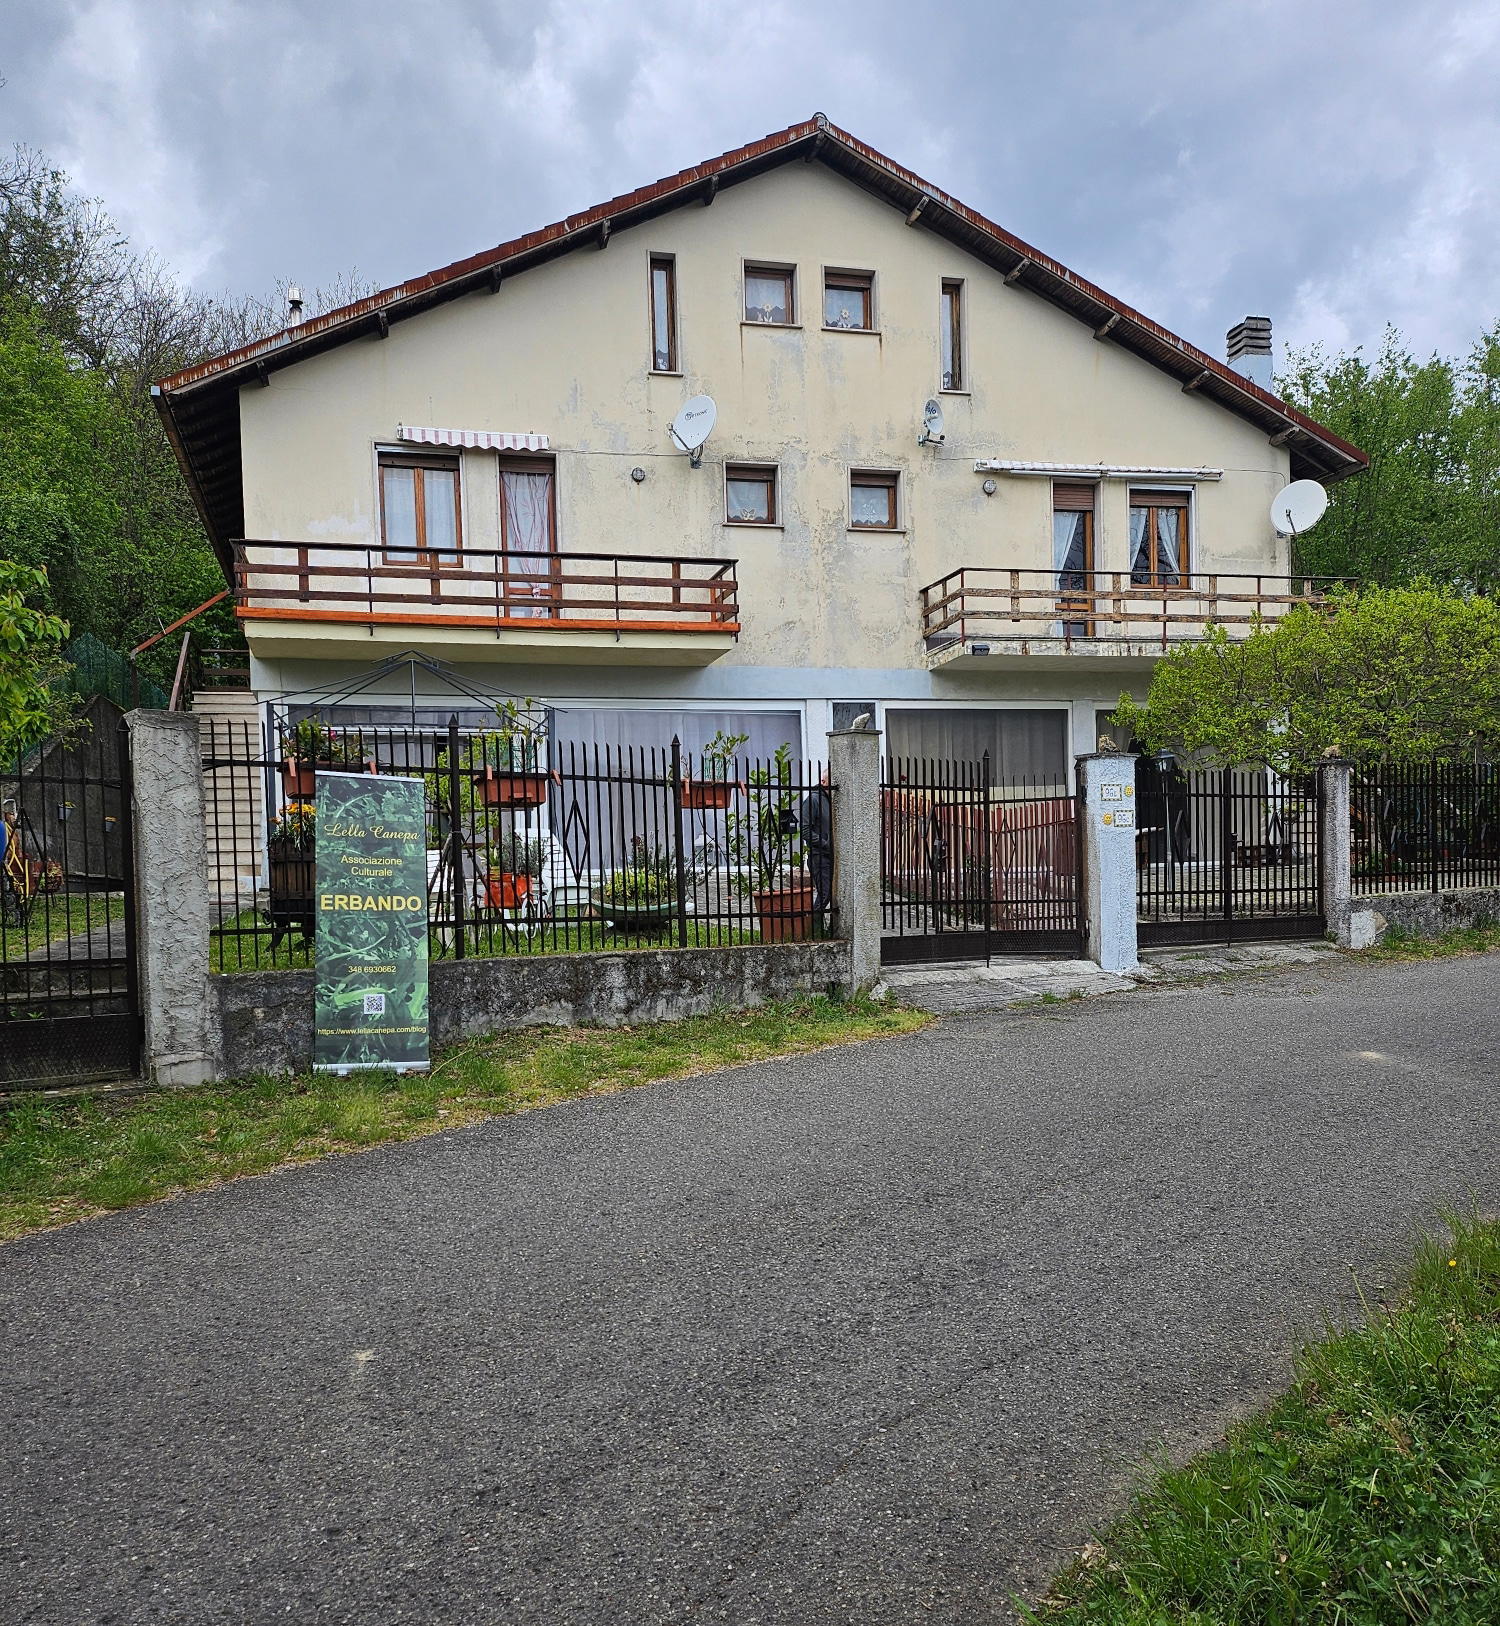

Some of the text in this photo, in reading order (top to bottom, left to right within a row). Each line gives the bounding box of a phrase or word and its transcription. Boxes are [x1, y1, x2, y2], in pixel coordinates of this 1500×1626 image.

[323, 823, 420, 843] Lella Canepa
[340, 854, 403, 865] Associazione
[351, 866, 393, 877] Culturale
[320, 894, 422, 912] ERBANDO
